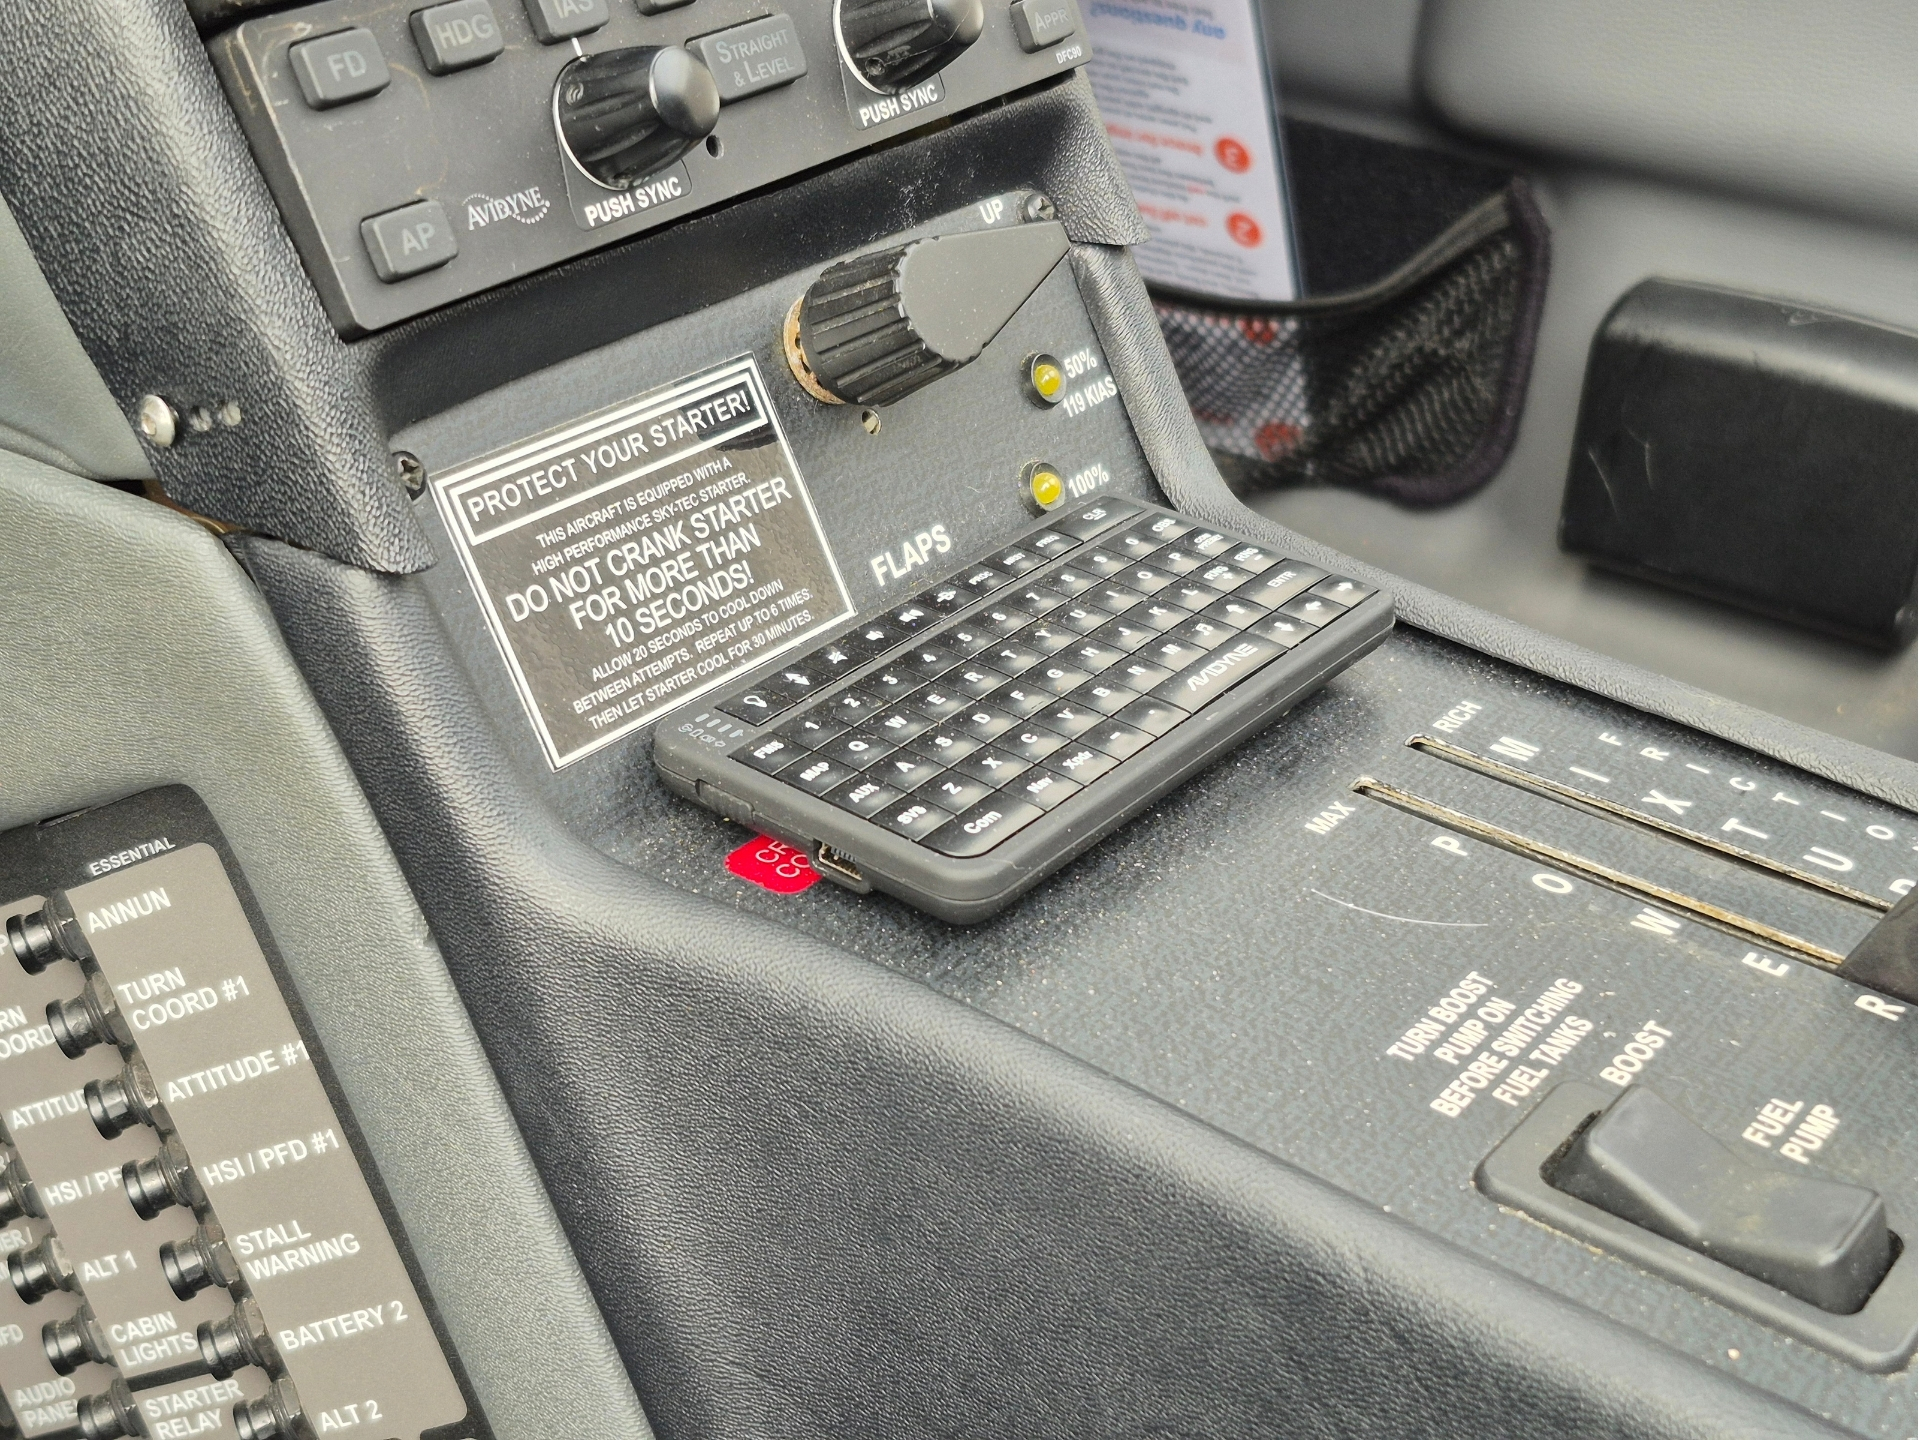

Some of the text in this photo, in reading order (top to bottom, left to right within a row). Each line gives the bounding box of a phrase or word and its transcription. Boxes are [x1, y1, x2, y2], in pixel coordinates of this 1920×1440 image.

[437, 15, 494, 49] HDG
[1034, 9, 1069, 33] APPR
[715, 28, 789, 64] STRAIGHT
[1056, 46, 1082, 64] DFC90
[328, 51, 366, 82] FD
[735, 55, 795, 87] & LEVEL
[859, 84, 939, 127] PUSH SYNC
[466, 187, 545, 230] AVIDYNE
[584, 177, 682, 227] PUSH SYNC
[979, 200, 1004, 224] UP
[402, 223, 437, 256] AP
[1064, 349, 1097, 379] 50%
[1062, 375, 1117, 418] 119 KIAS
[467, 389, 751, 522] PROTECT YOUR STARTER!
[1068, 464, 1109, 498] 100%
[536, 457, 732, 549] THIS AIRCRAFT IS EQUIPPED WITH A
[1082, 508, 1107, 521] CLR
[532, 473, 751, 577] HIGH PERFORMANCE SKY-TEC STARTER.
[505, 477, 792, 623] DO NOT CRANK STARTER
[871, 525, 951, 586] FLAPS
[1168, 553, 1182, 561] P
[568, 523, 762, 631] FOR MORE THAN
[1267, 570, 1296, 589] ENTR
[605, 560, 754, 649] 10 SECONDS!
[1026, 592, 1040, 601] 7
[1149, 606, 1167, 616] K
[591, 579, 784, 682] ALLOW 20 SECONDS TO COOL DOWN
[991, 612, 1007, 621] 6
[1070, 610, 1087, 618] U
[1035, 629, 1051, 638] Y
[1161, 644, 1182, 655] M
[573, 588, 813, 715] BETWEEN ATTEMPTS. REPEAT UP TO 6 TIMES.
[1000, 650, 1017, 659] T
[1080, 647, 1100, 657] H
[1187, 643, 1258, 691] AVIDYNE
[588, 609, 815, 730] THEN LET STARTER COOL FOR 30 MINUTES.
[964, 671, 984, 682] R
[1046, 669, 1064, 679] G
[1127, 666, 1146, 675] N
[927, 694, 946, 704] E
[1010, 690, 1025, 700] F
[1093, 688, 1111, 697] B
[971, 713, 991, 723] D
[1433, 701, 1482, 735] RICH
[753, 740, 785, 760] FMS
[1021, 733, 1038, 743] C
[800, 762, 830, 782] MAP
[895, 761, 916, 773] A
[982, 756, 1003, 769] X
[1062, 751, 1093, 770] Xpdr
[848, 783, 880, 803] AUX
[942, 782, 962, 795] Z
[1027, 776, 1053, 793] Nav
[963, 810, 1002, 834] Com
[1305, 800, 1355, 837] MAX
[89, 837, 176, 876] ESSENTIAL
[87, 887, 172, 933] ANNUN
[118, 967, 186, 1005] TURN
[132, 976, 250, 1031] COORD #1
[1386, 970, 1494, 1063] TURN BOOST
[0, 1024, 56, 1059] OORD
[1430, 977, 1584, 1119] BEFORE SWITCHING
[1433, 997, 1517, 1065] PUMP ON
[1492, 1016, 1594, 1107] FUEL TANKS
[1599, 1020, 1673, 1087] BOOST
[166, 1040, 310, 1103] ATTITUDE #1
[1742, 1097, 1805, 1148] FUEL
[1780, 1104, 1841, 1165] PUMP
[204, 1159, 245, 1187] HSI
[259, 1139, 308, 1170] PFD
[311, 1129, 340, 1153] #1
[45, 1176, 83, 1205] HSI
[95, 1166, 122, 1193] PF
[236, 1220, 312, 1255] STALL
[83, 1250, 137, 1282] ALT 1
[246, 1233, 361, 1280] WARNING
[111, 1311, 178, 1344] CABIN
[280, 1300, 408, 1352] BATTERY 2
[122, 1332, 198, 1366] LIGHTS
[16, 1377, 76, 1407] AUDIO
[145, 1379, 245, 1418] STARTER
[23, 1399, 78, 1428] PANE
[156, 1408, 223, 1440] RELAY
[319, 1400, 383, 1434] ALT 2
